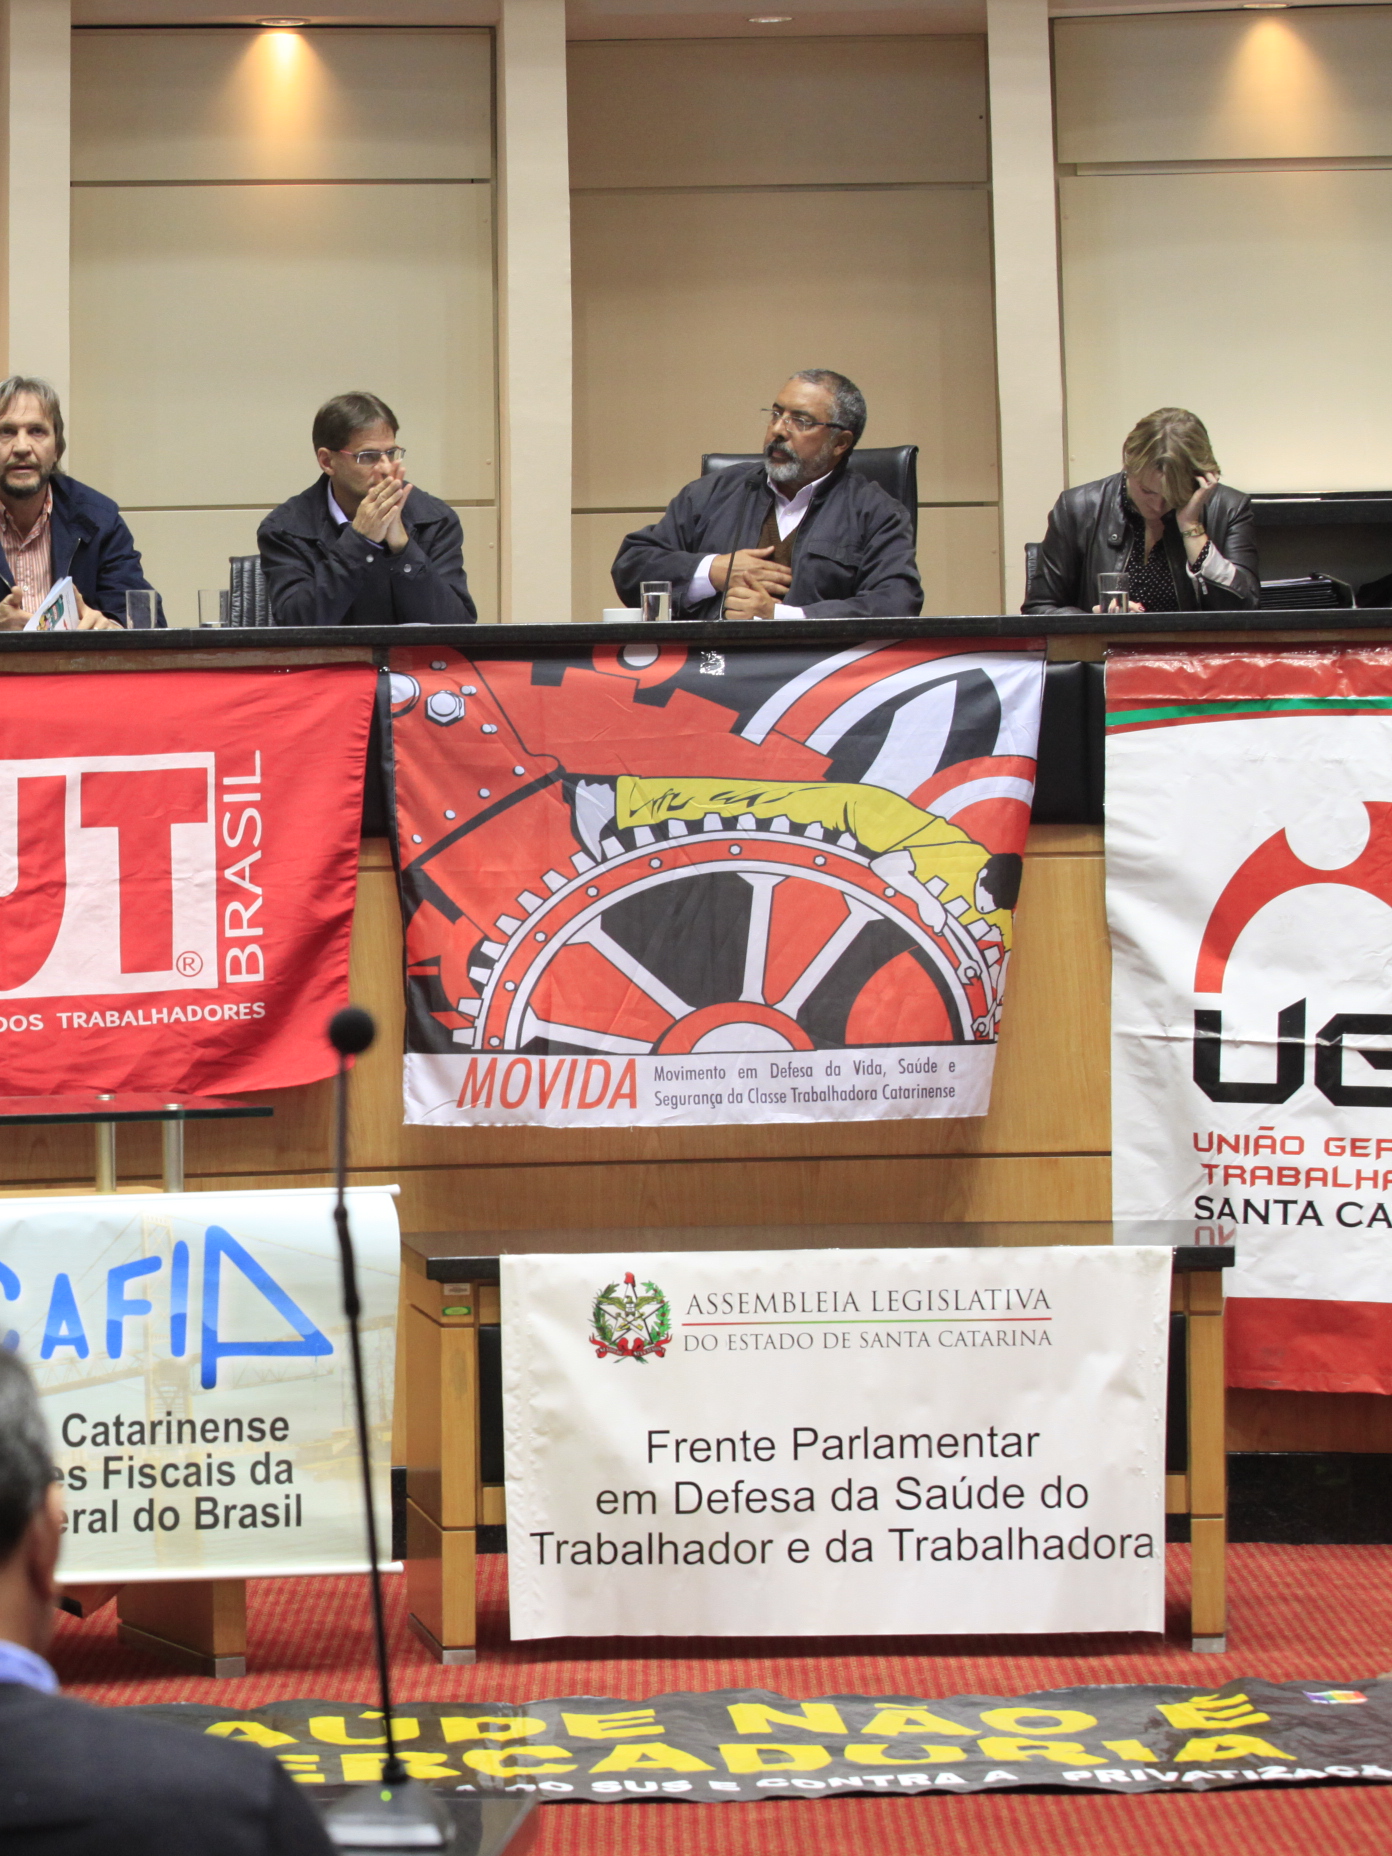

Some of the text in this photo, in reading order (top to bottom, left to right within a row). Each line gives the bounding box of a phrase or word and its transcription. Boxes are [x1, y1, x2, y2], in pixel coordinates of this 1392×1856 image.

[223, 750, 265, 983] BRASIL
[56, 1001, 266, 1030] TRABALHADORES
[456, 1057, 638, 1110] MOVIDA
[654, 1056, 956, 1082] Movimento em Defesa da Vida, Saúde e
[654, 1083, 956, 1109] Segurança da Classe Trabalhadora Catarinense
[1193, 1126, 1392, 1161] UNIÃO GER
[1200, 1163, 1392, 1192] TRABALH
[1194, 1195, 1392, 1229] SANTA CA
[686, 1288, 1052, 1315] ASSEMBLEIA LEGISLATIVA
[683, 1334, 718, 1352] DO
[727, 1332, 814, 1351] ESTADO
[823, 1332, 851, 1349] DE
[859, 1330, 931, 1348] SANTA
[938, 1329, 1052, 1347] CATARINA
[62, 1410, 290, 1448] Catarinense
[647, 1426, 1040, 1463] Frente Parlamentar
[103, 1453, 236, 1490] Fiscais
[250, 1451, 294, 1485] da
[133, 1498, 180, 1532] do
[195, 1493, 302, 1530] Brasil
[596, 1475, 1089, 1515] em Defesa da Saúde do
[529, 1526, 1155, 1565] Trabalhador e da Trabalhadora
[203, 1693, 1271, 1748] AÚDE NÃO É
[591, 1780, 693, 1793] SUS
[708, 1780, 740, 1792] E
[756, 1772, 968, 1789] CONTRA
[983, 1770, 1019, 1782] A
